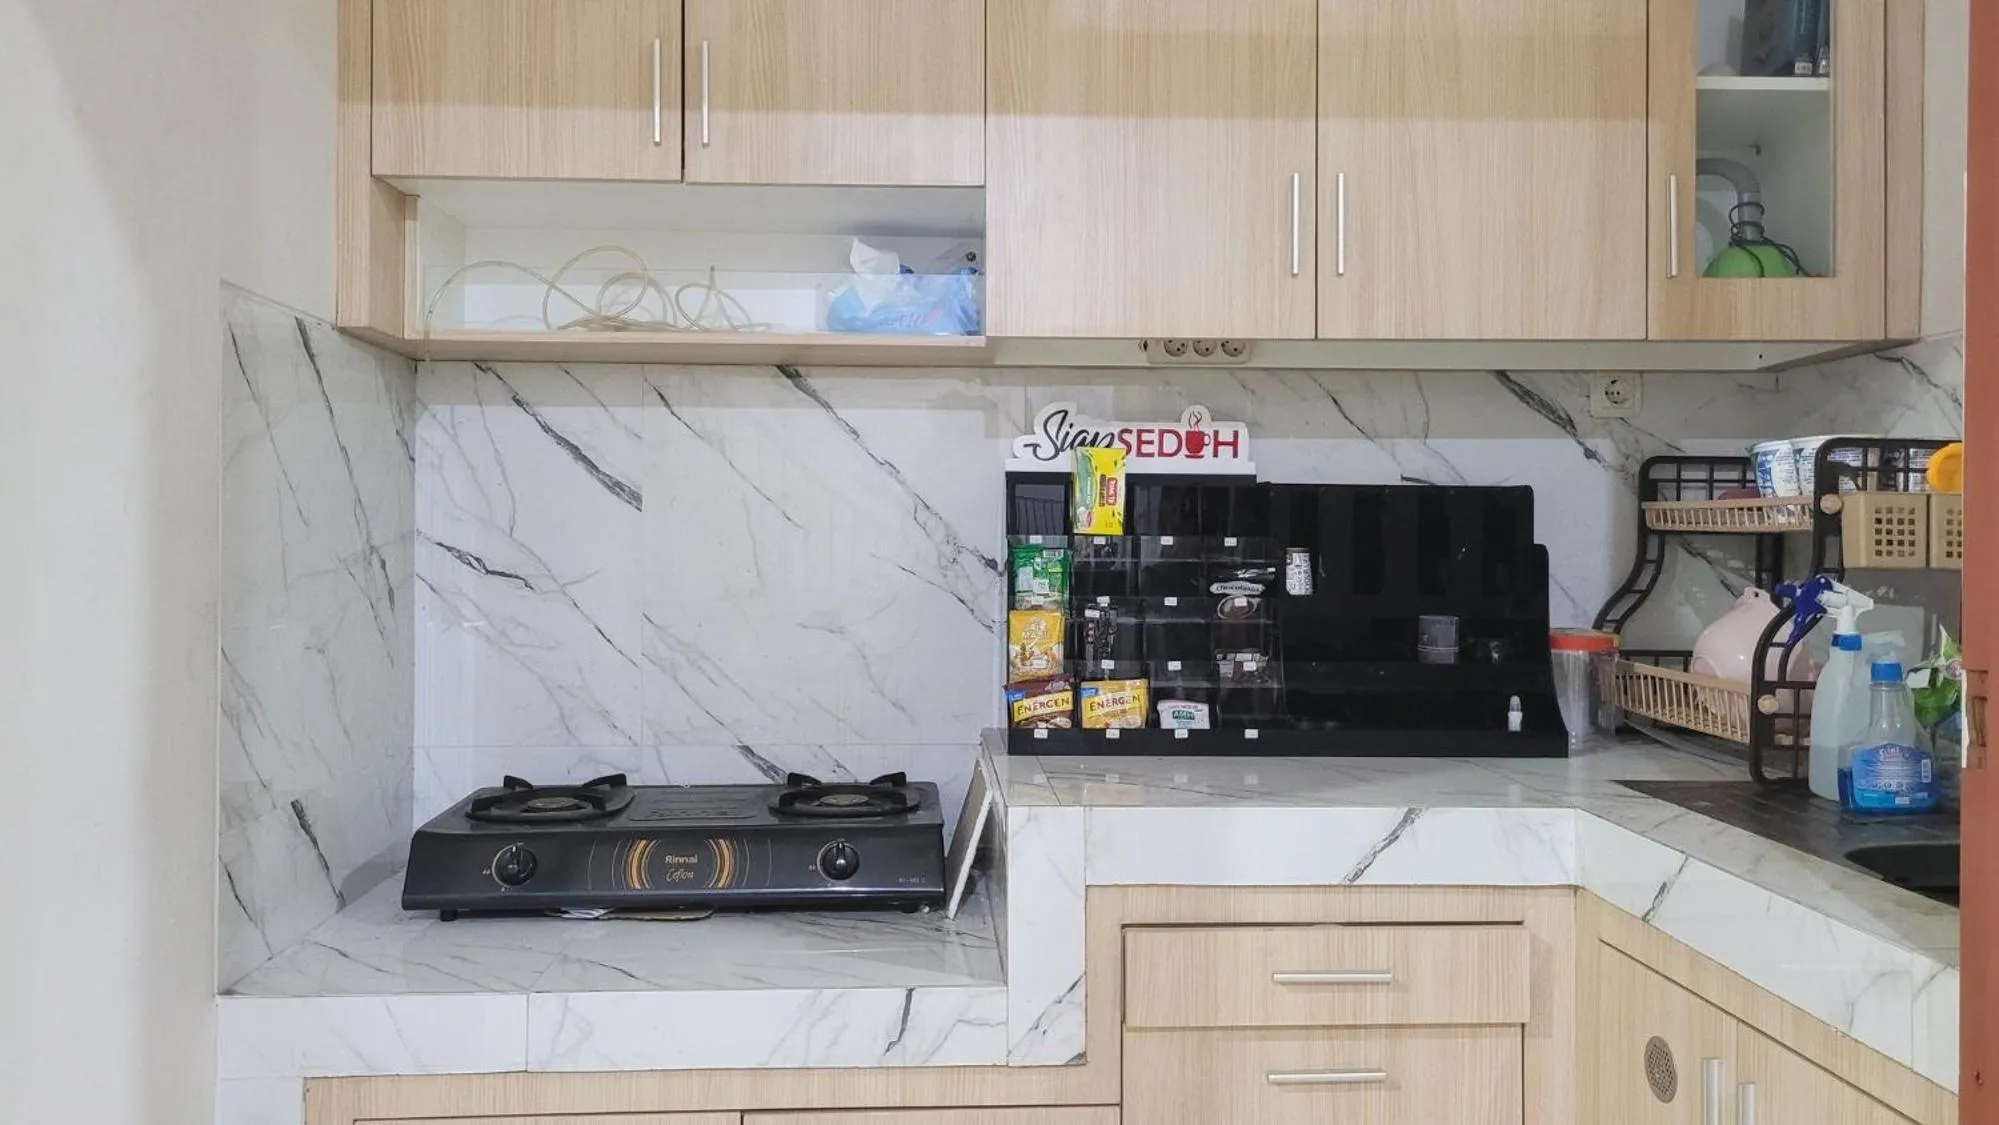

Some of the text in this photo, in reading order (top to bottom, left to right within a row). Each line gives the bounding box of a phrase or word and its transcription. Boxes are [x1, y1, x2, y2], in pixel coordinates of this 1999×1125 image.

[1017, 696, 1070, 715] ENERGEN
[1089, 694, 1141, 713] ENERGEN
[664, 854, 698, 865] Rinnai
